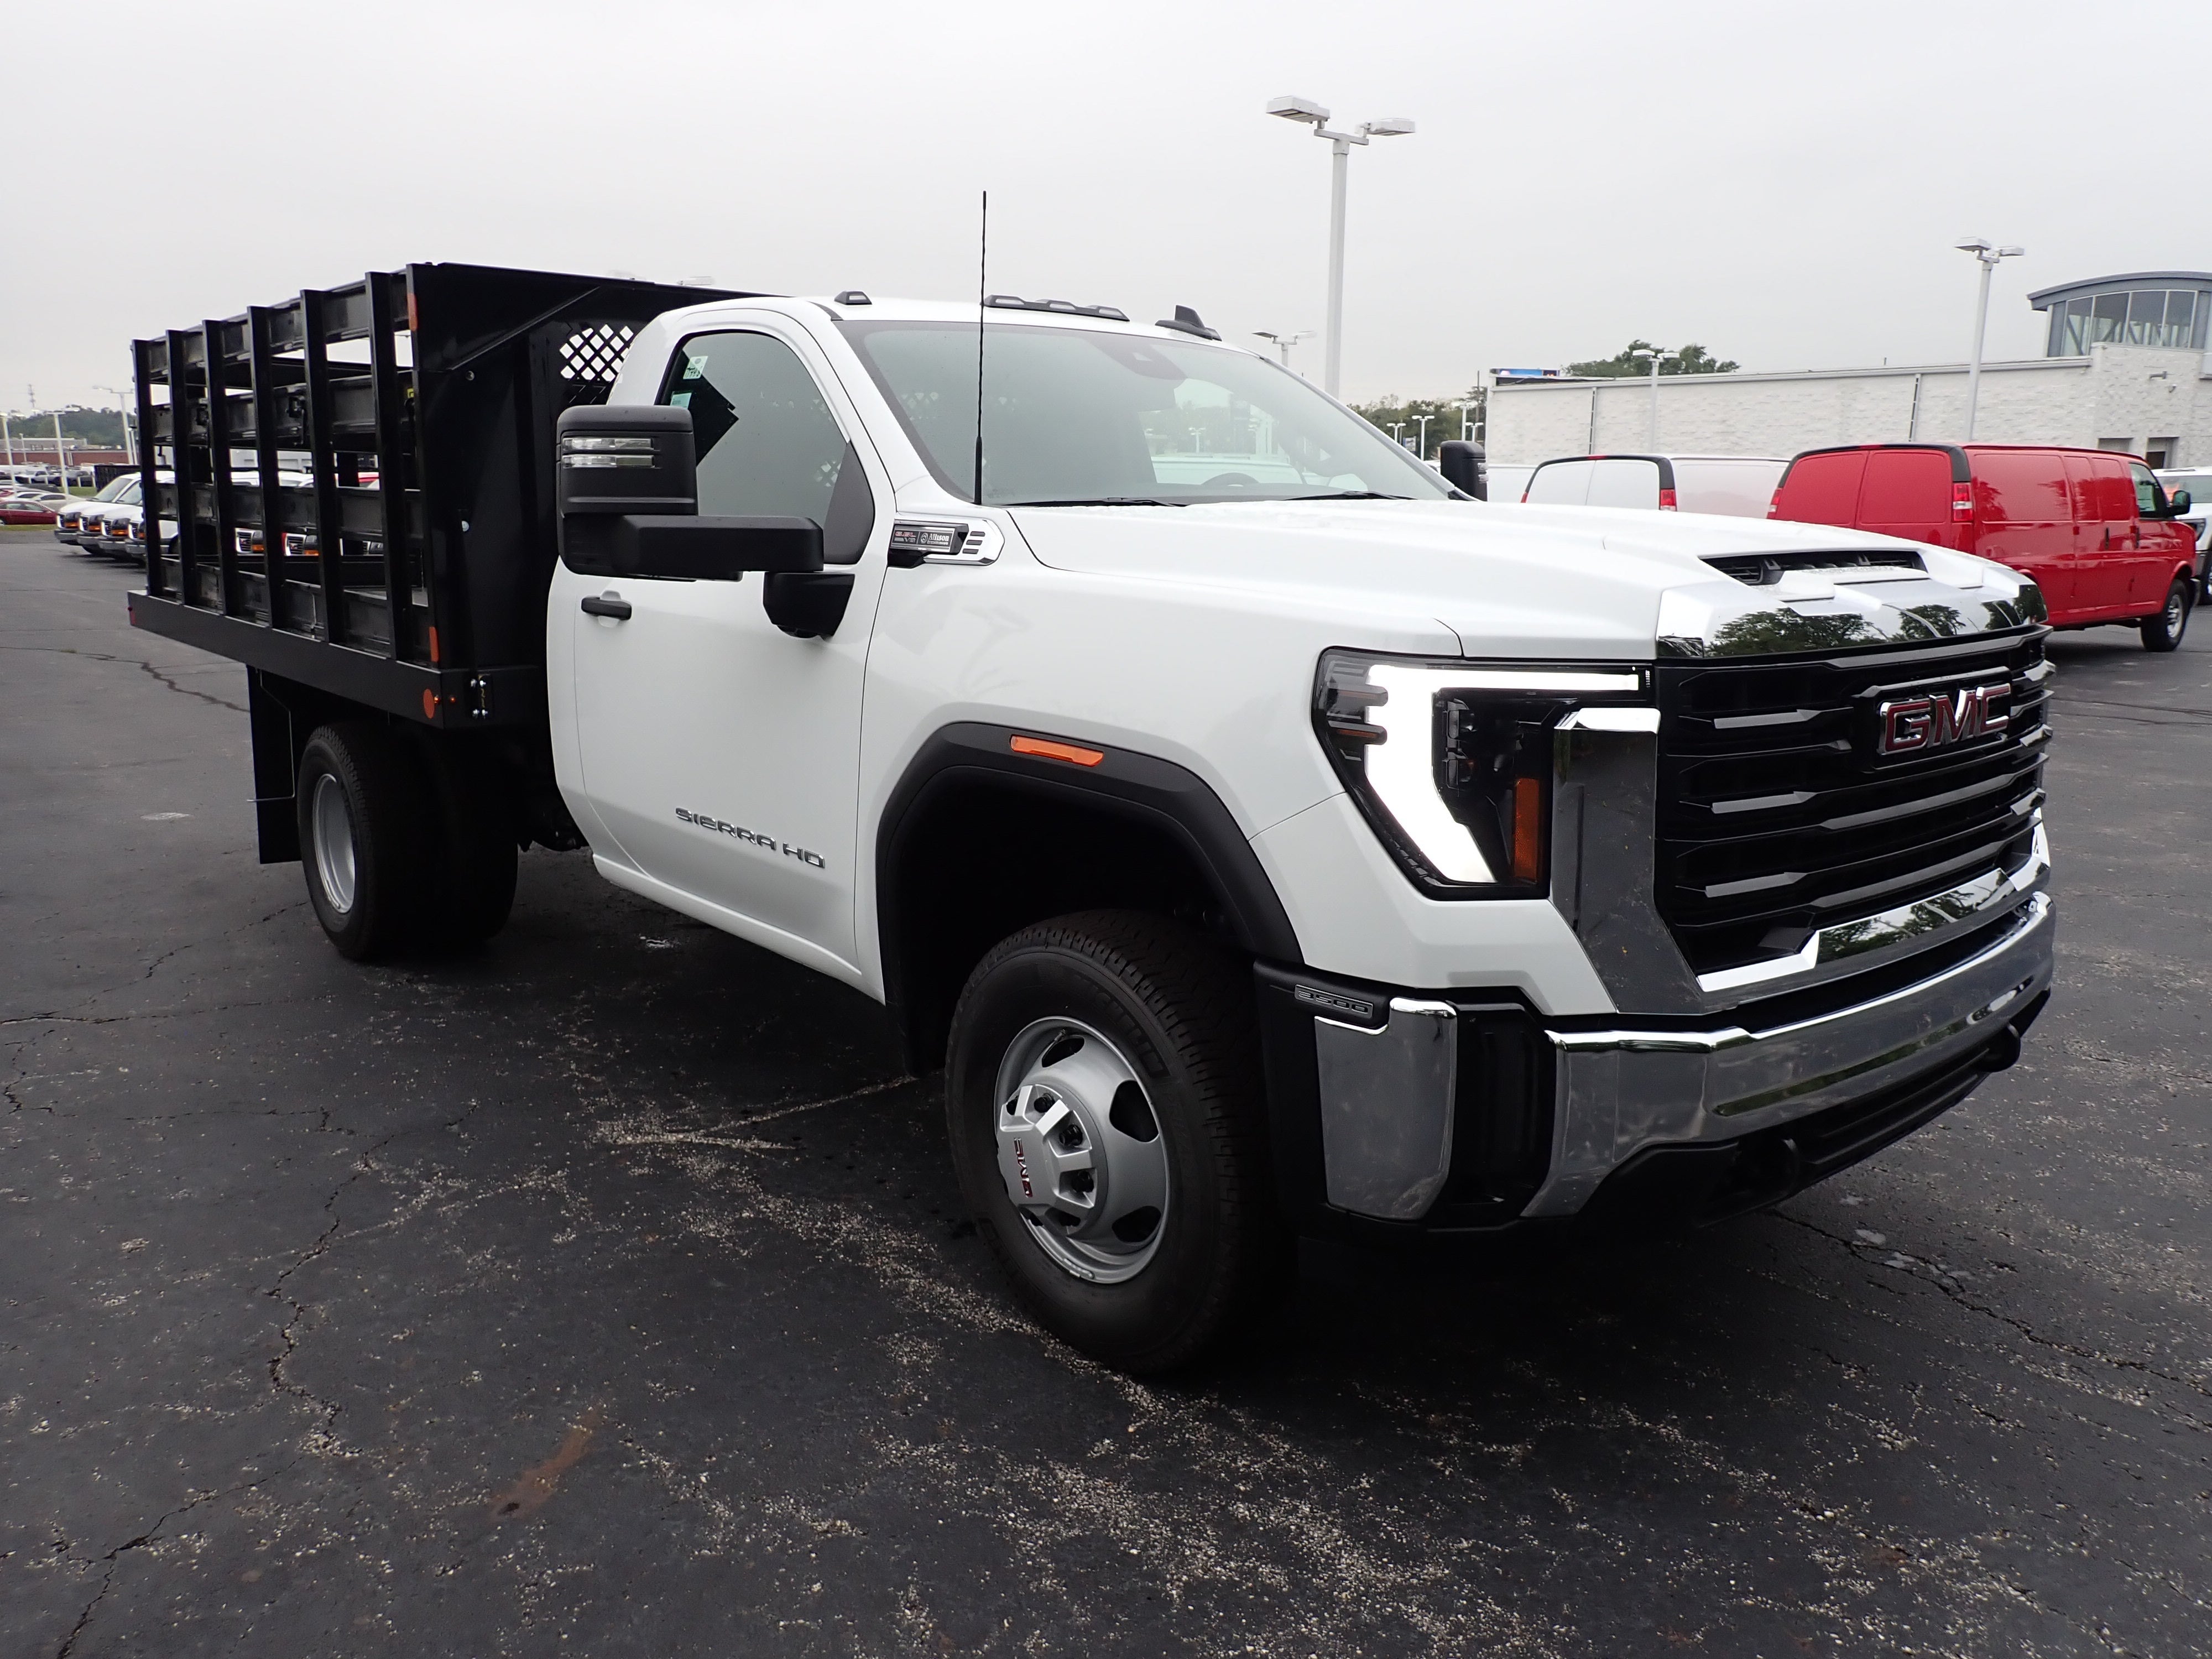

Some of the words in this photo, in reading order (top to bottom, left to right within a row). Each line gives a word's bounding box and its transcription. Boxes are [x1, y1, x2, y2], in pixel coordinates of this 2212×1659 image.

[928, 533, 950, 541] Allison
[1880, 683, 2011, 755] GMC
[782, 842, 826, 869] HD
[1298, 990, 1369, 1014] 3500
[1014, 1138, 1034, 1198] GMC
